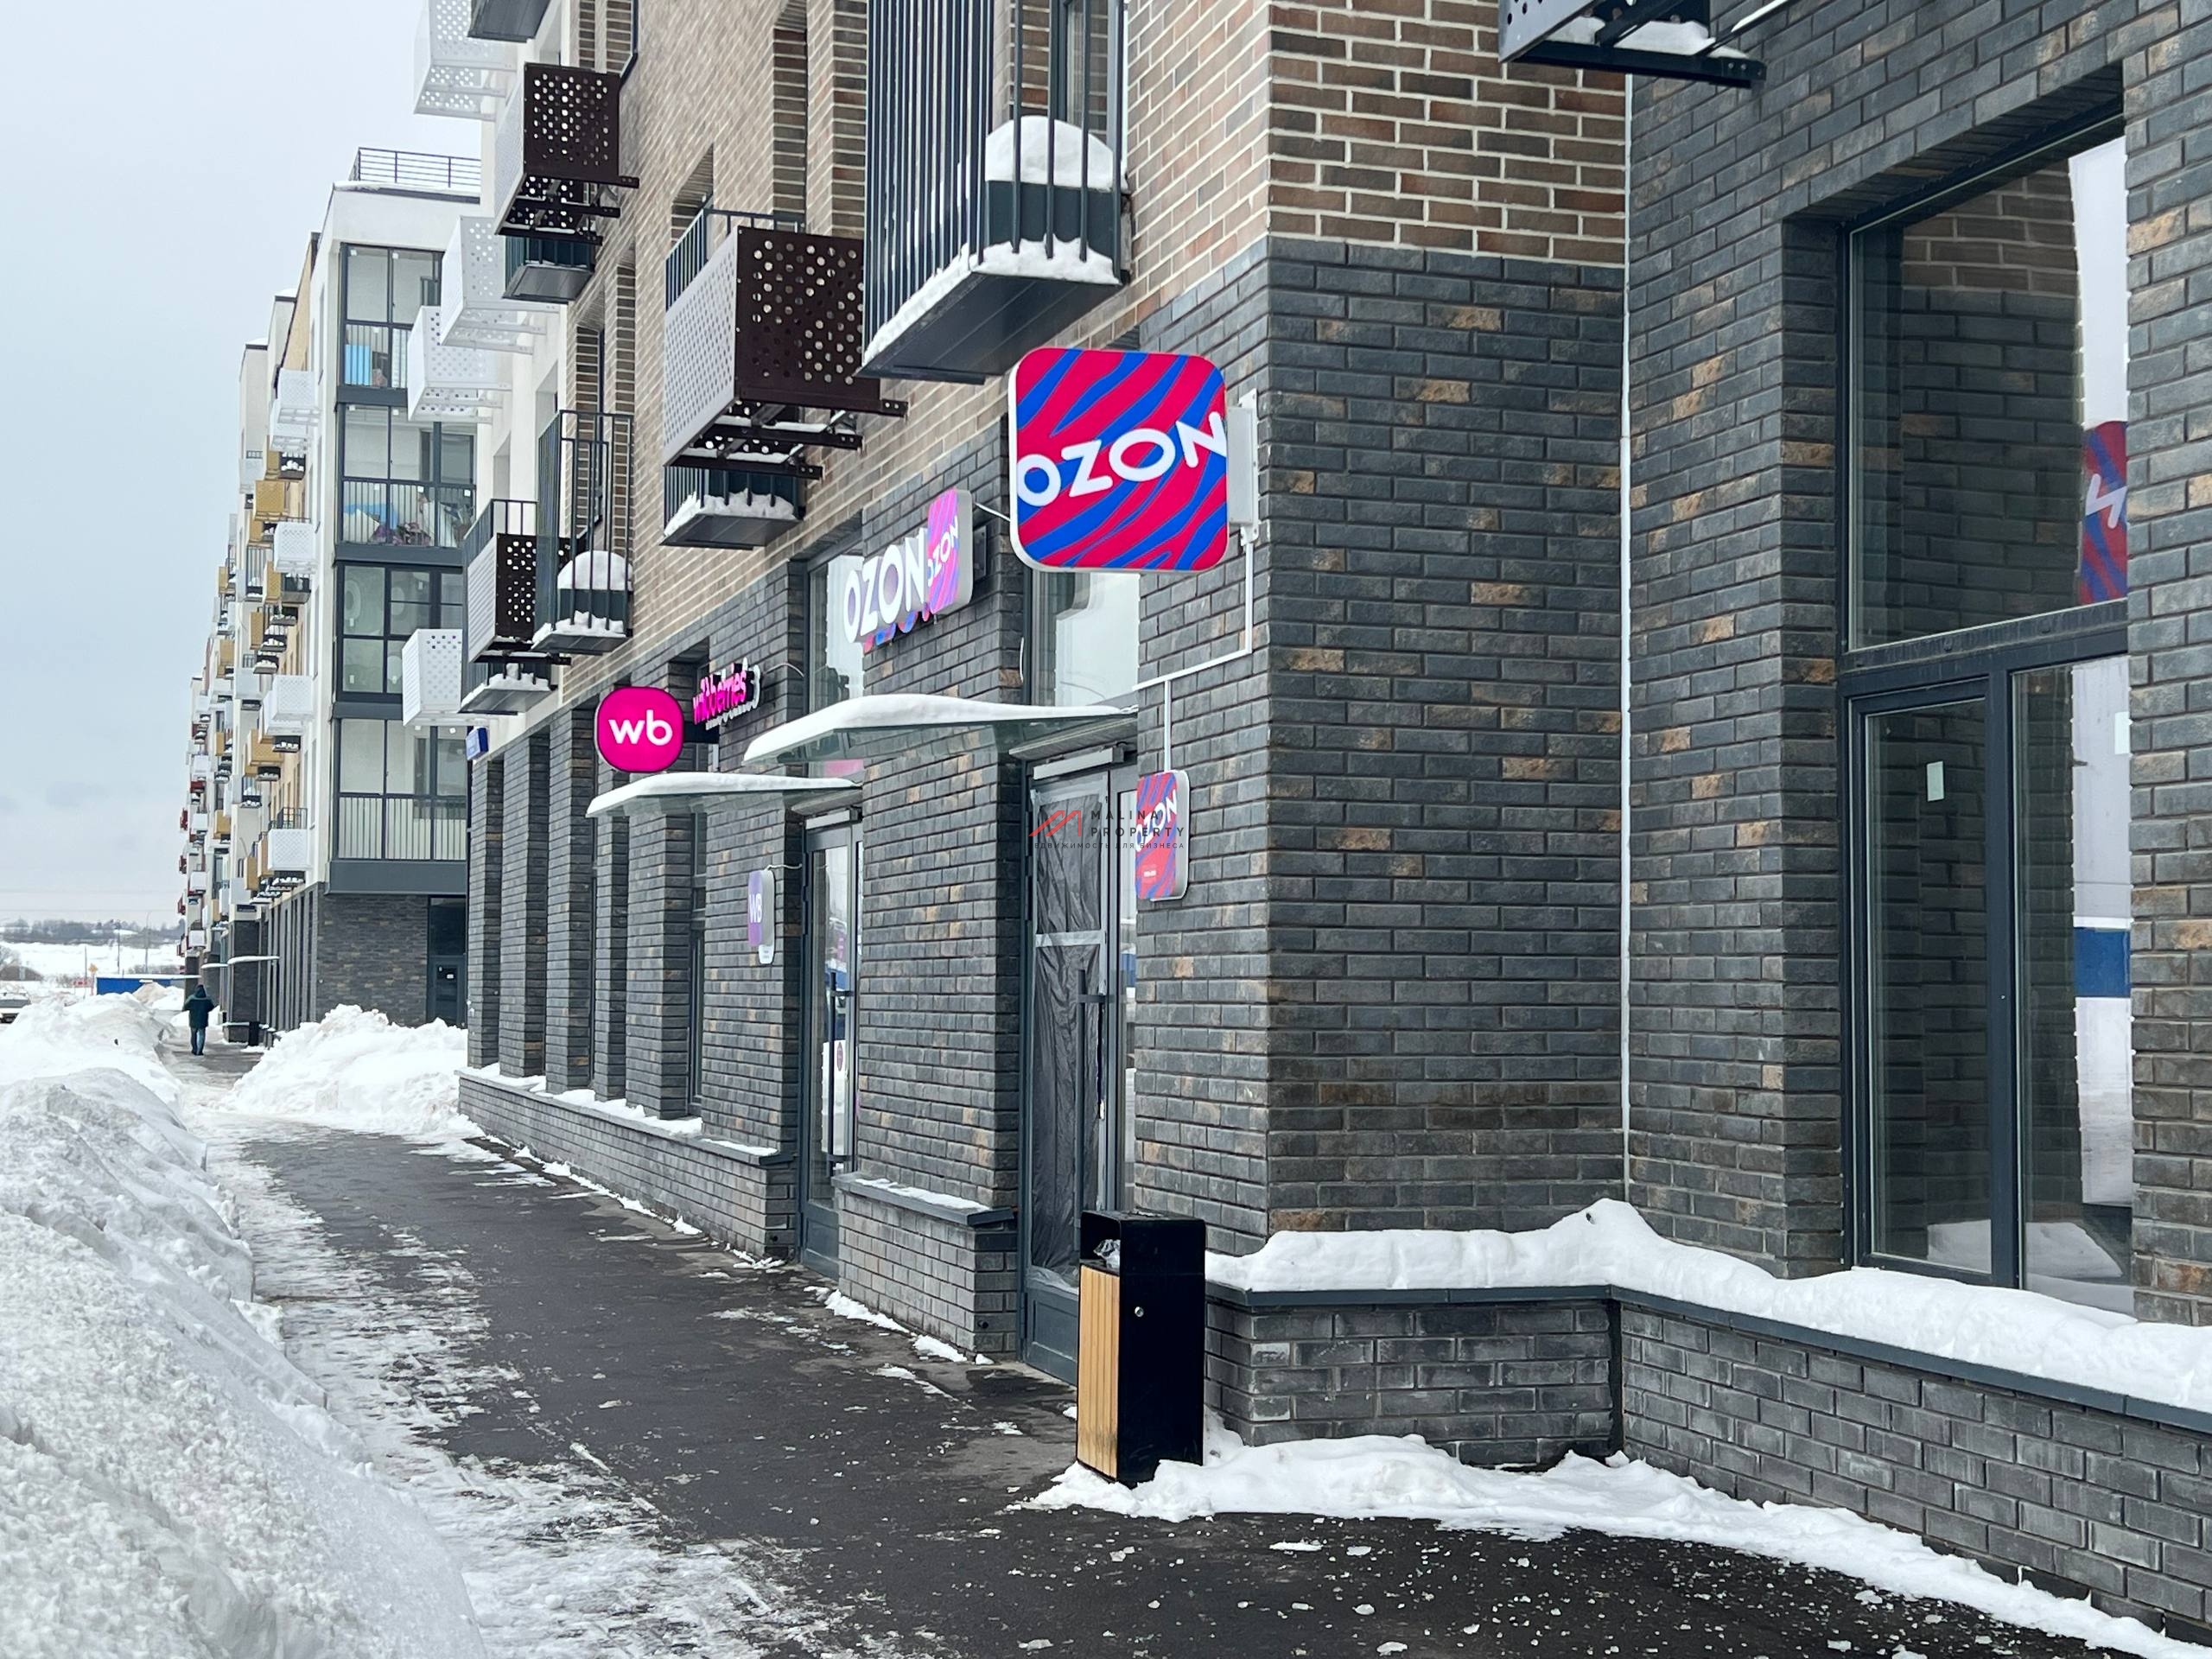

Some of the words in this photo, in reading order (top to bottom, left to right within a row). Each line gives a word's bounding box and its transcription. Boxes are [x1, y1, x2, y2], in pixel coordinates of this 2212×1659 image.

[1017, 411, 1227, 507] OZON
[843, 528, 929, 643] OZON
[608, 709, 672, 746] wb
[1135, 789, 1178, 852] OZON
